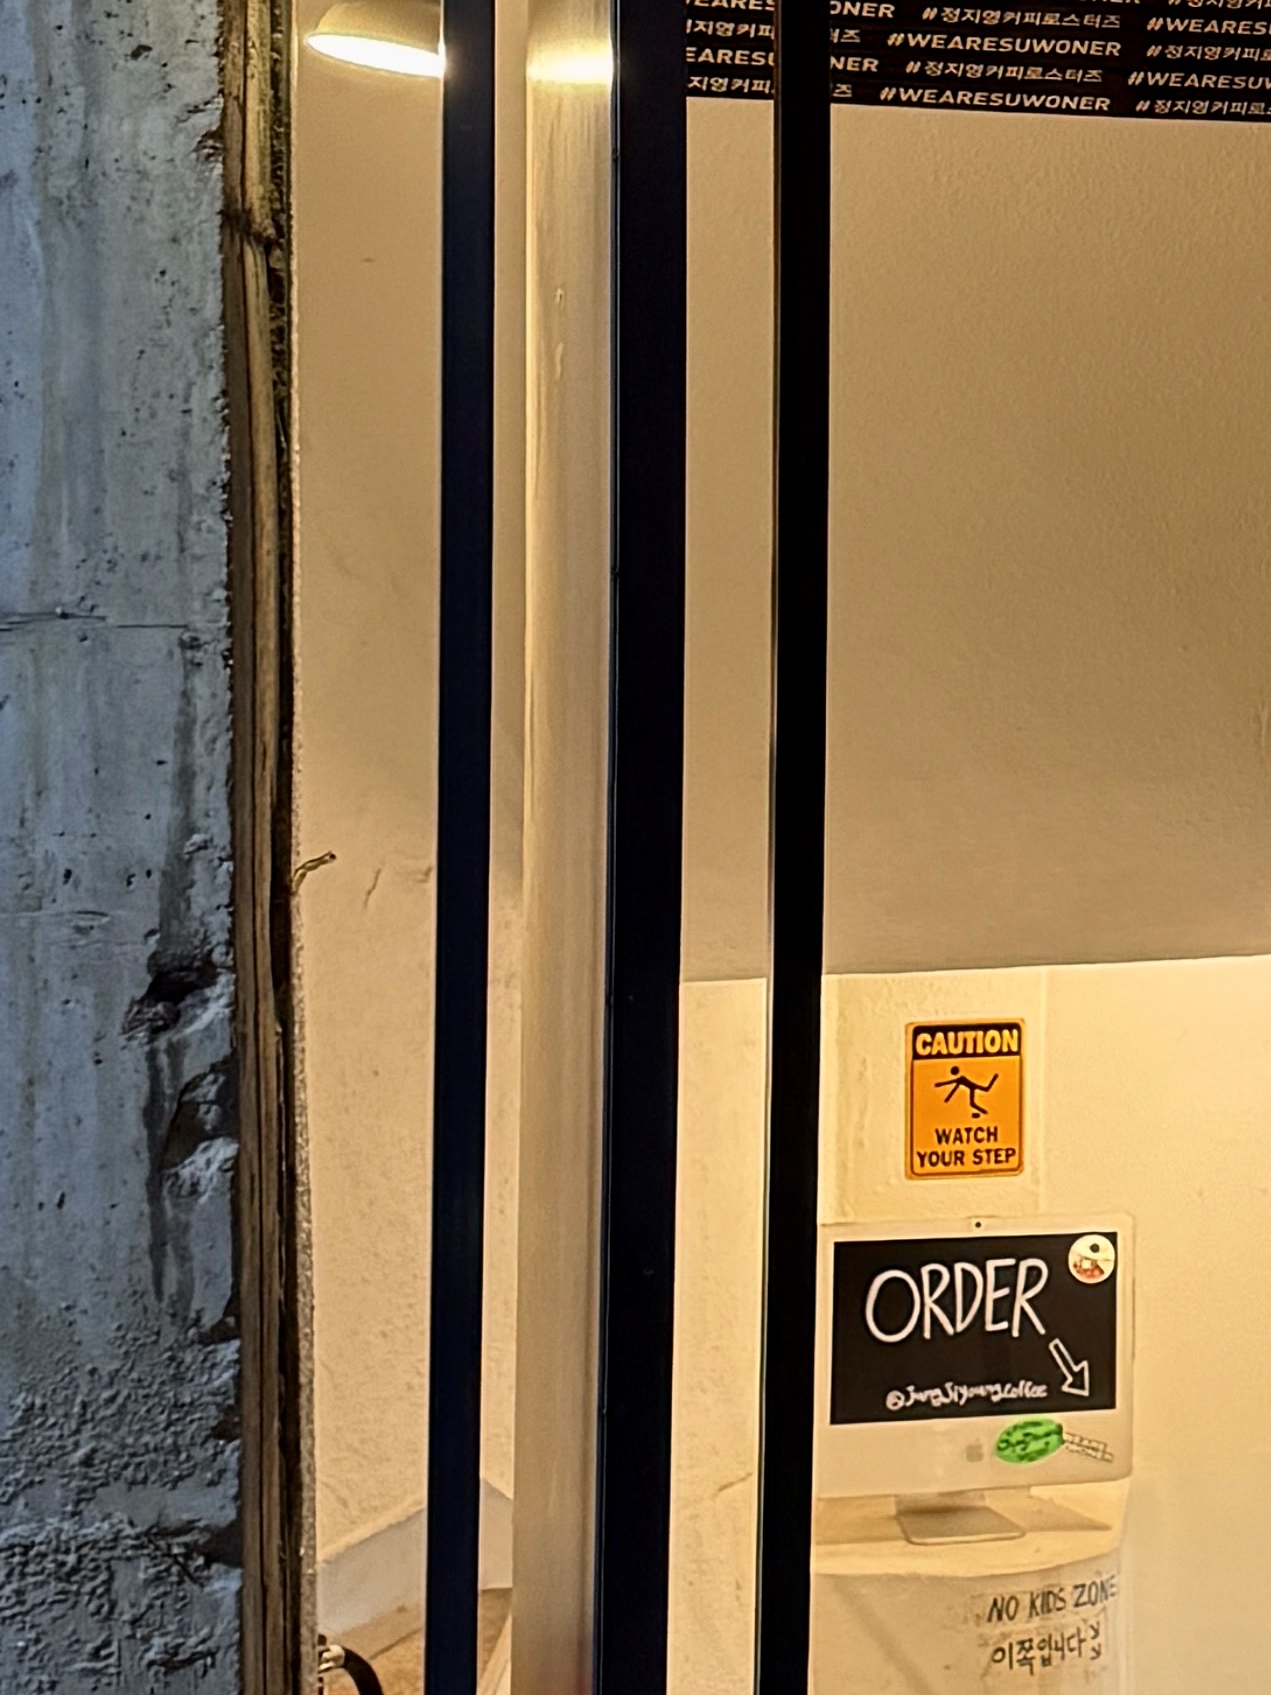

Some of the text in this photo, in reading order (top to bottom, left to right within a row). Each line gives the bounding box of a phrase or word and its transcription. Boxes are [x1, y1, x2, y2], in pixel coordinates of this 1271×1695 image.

[887, 32, 1122, 57] #WEARESUWONER
[879, 86, 1111, 111] #WEARESUWONER
[914, 1028, 1020, 1056] CAUTION
[934, 1125, 999, 1146] WATCH
[916, 1147, 1017, 1169] YOUR STEP
[865, 1257, 1049, 1344] ORDER
[986, 1575, 1119, 1623] NO KIDS ZONE
[991, 1625, 1087, 1676] 이쪽입니다
